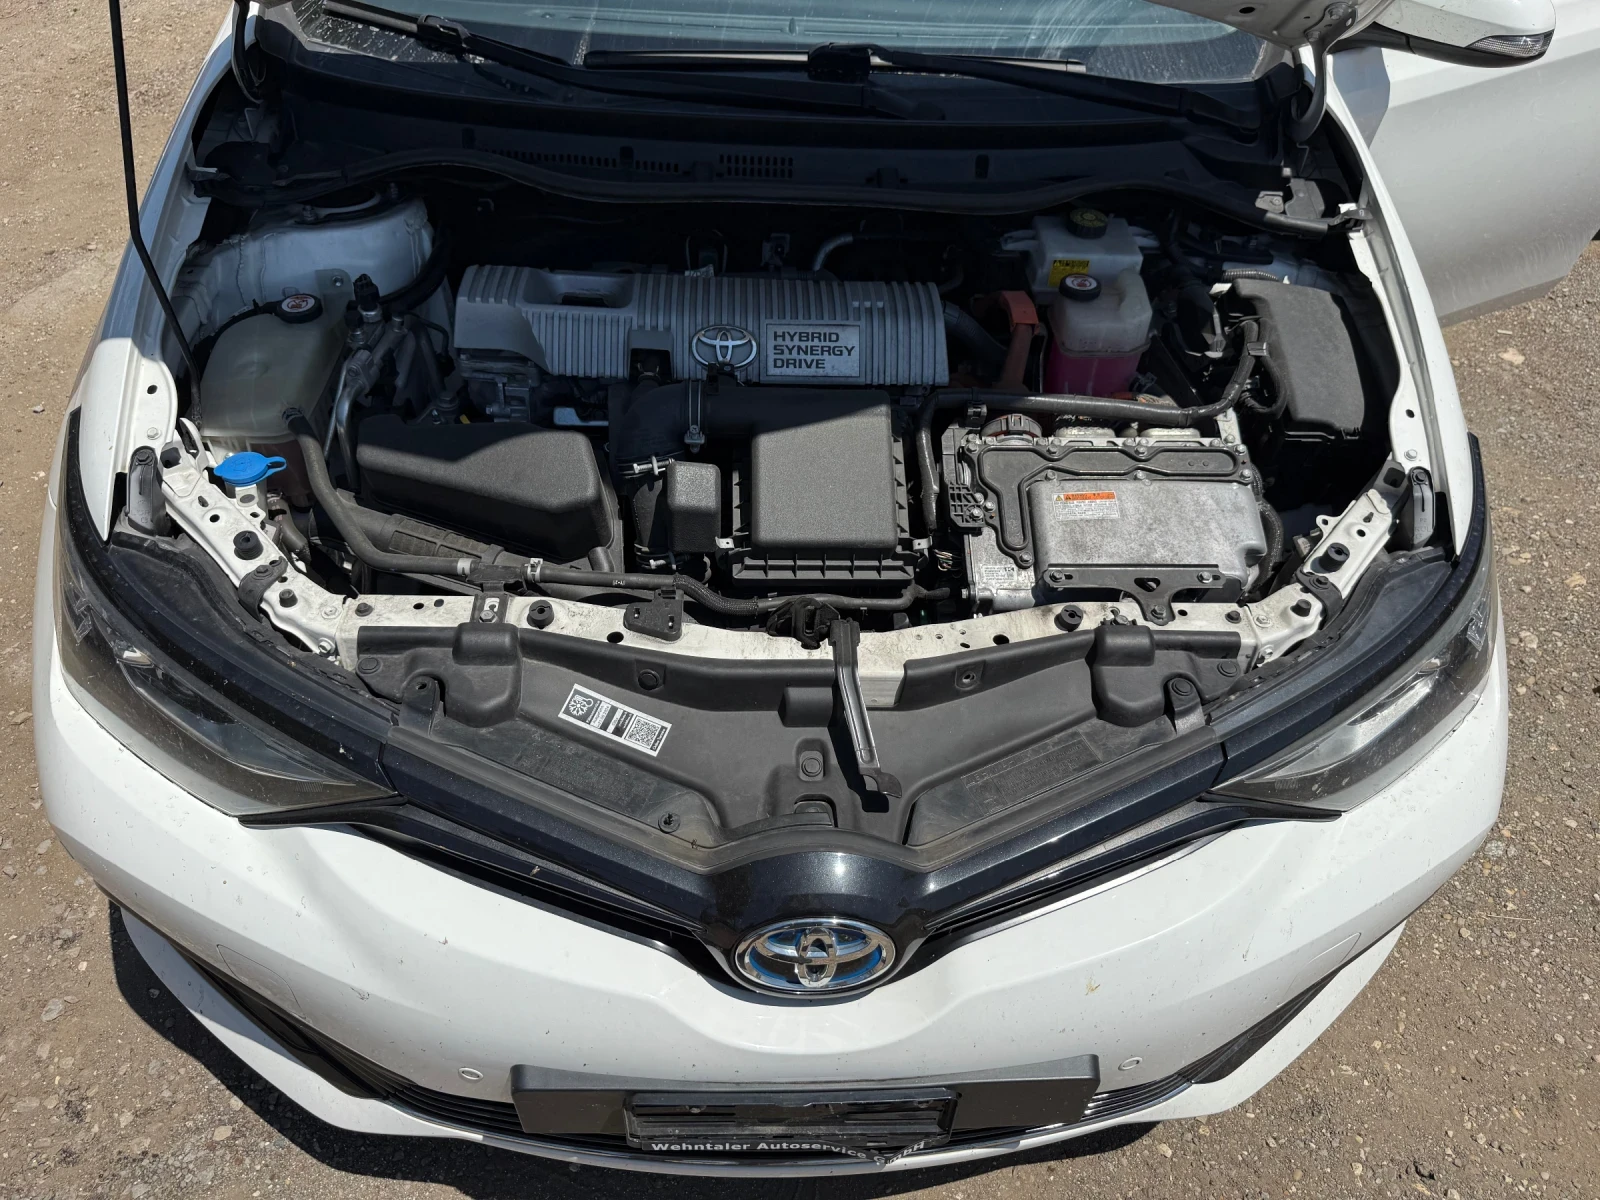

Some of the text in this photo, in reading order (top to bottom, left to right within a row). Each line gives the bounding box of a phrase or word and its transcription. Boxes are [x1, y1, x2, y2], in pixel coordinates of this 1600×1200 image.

[773, 330, 840, 343] HYBRID
[773, 344, 856, 357] SYNERGY
[773, 358, 826, 369] DRIVE
[651, 1142, 750, 1151] Wehntaler
[757, 1141, 867, 1159] Autoservice
